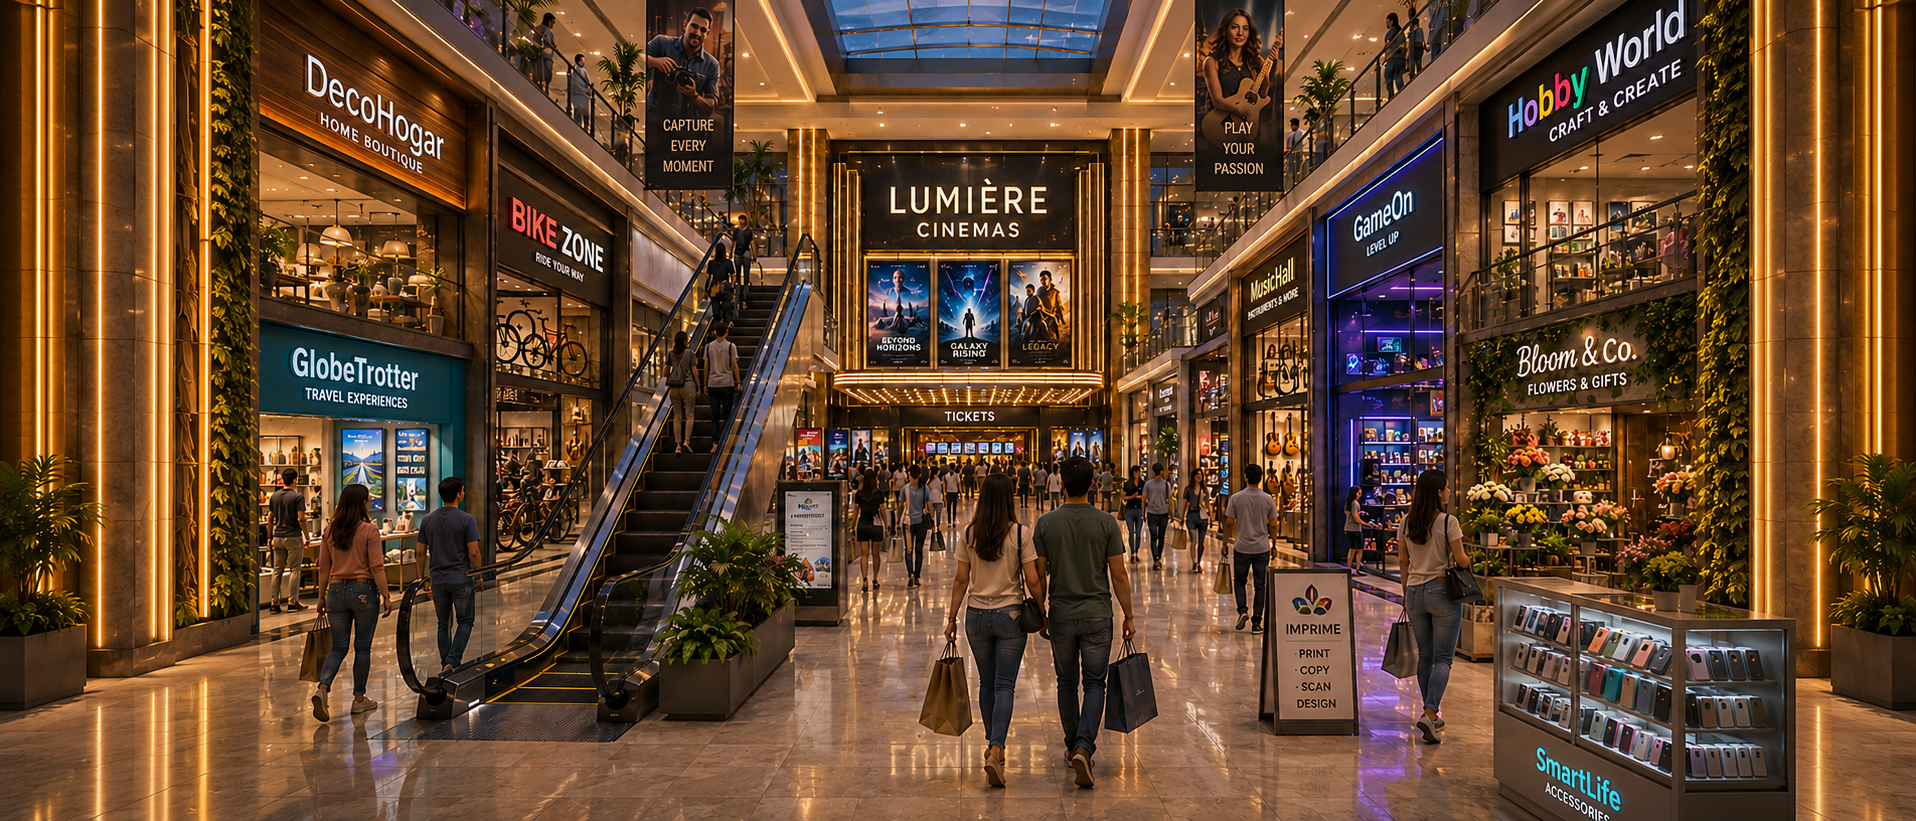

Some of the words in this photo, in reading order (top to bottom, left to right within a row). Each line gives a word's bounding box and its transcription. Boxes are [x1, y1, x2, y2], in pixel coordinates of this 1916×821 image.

[1508, 66, 1589, 138] Hobby
[1594, 0, 1686, 84] World
[308, 54, 444, 160] DecoHogar
[1549, 106, 1594, 142] CRAFT
[1599, 100, 1609, 116] &
[1614, 58, 1682, 108] CREATE
[663, 119, 714, 132] CAPTURE
[1224, 122, 1254, 134] PLAY
[320, 112, 359, 143] HOME
[364, 134, 422, 174] BOUTIQUE
[671, 140, 706, 152] EVERY
[1223, 142, 1254, 154] YOUR
[663, 160, 714, 172] MOMENT
[1214, 162, 1264, 174] PASSION
[890, 178, 1048, 214] LUMIÈRE
[1354, 190, 1412, 242] GameOn
[511, 196, 557, 250] BIKE
[562, 225, 604, 273] ZONE
[917, 222, 1020, 238] CINEMAS
[1366, 238, 1387, 257] LEVEL
[1388, 231, 1399, 245] UP
[536, 252, 552, 268] RIDE
[552, 260, 571, 277] YOUR
[571, 268, 584, 282] WAY
[1250, 257, 1294, 303] MusicHall
[1516, 344, 1578, 377] Bloom
[1582, 336, 1598, 366] &
[1602, 338, 1638, 363] Co.
[292, 347, 419, 391] GlobeTrotter
[1528, 378, 1576, 396] FLOWERS
[1580, 377, 1588, 390] &
[1592, 372, 1627, 388] GIFTS
[305, 387, 344, 403] TRAVEL
[347, 392, 408, 409] EXPERIENCES
[944, 411, 995, 422] TICKETS
[1286, 624, 1341, 634] IMPRIME
[1299, 649, 1330, 658] PRINT
[1300, 666, 1330, 674] COPY
[1302, 682, 1331, 691] SCAN
[1297, 699, 1336, 708] DESIGN
[1536, 747, 1621, 811] SmartLife
